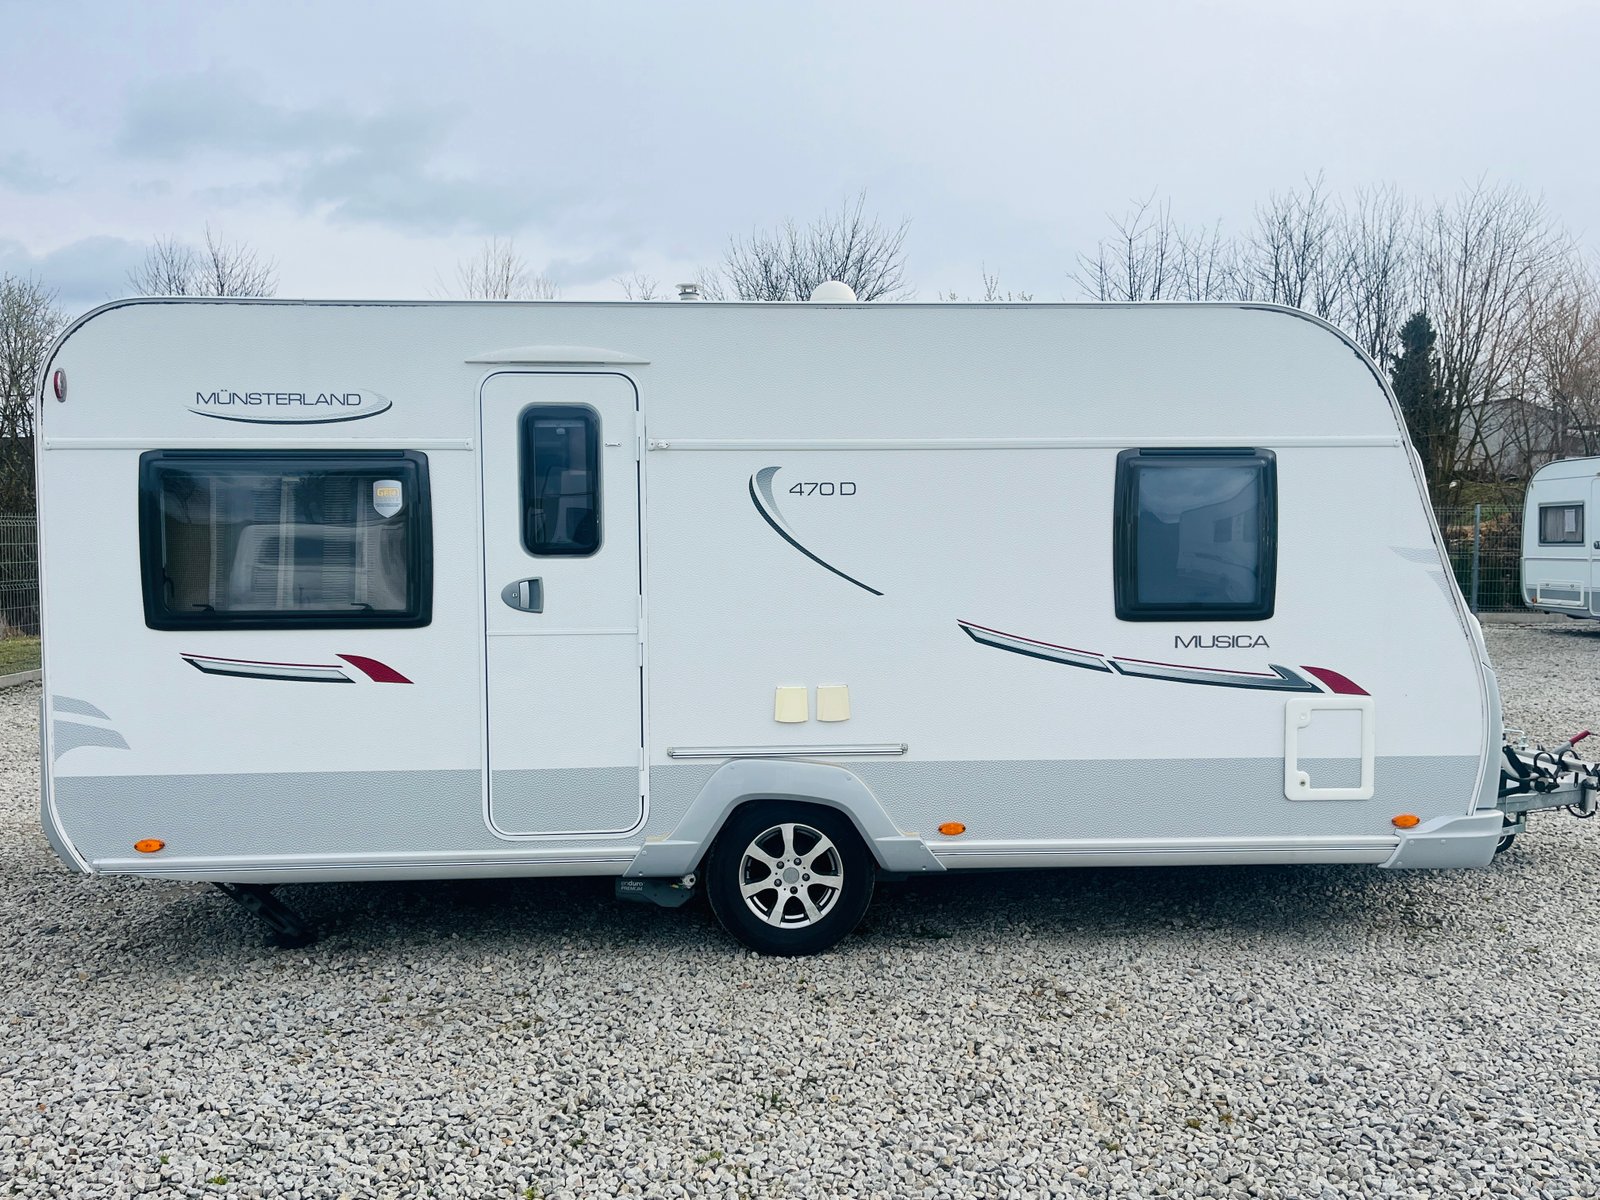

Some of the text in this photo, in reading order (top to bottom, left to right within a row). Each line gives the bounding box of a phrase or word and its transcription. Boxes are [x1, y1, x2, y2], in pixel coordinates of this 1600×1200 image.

[196, 389, 362, 406] MÜNSTERLAND
[789, 482, 857, 496] 470 D
[1174, 635, 1270, 648] MUSICA
